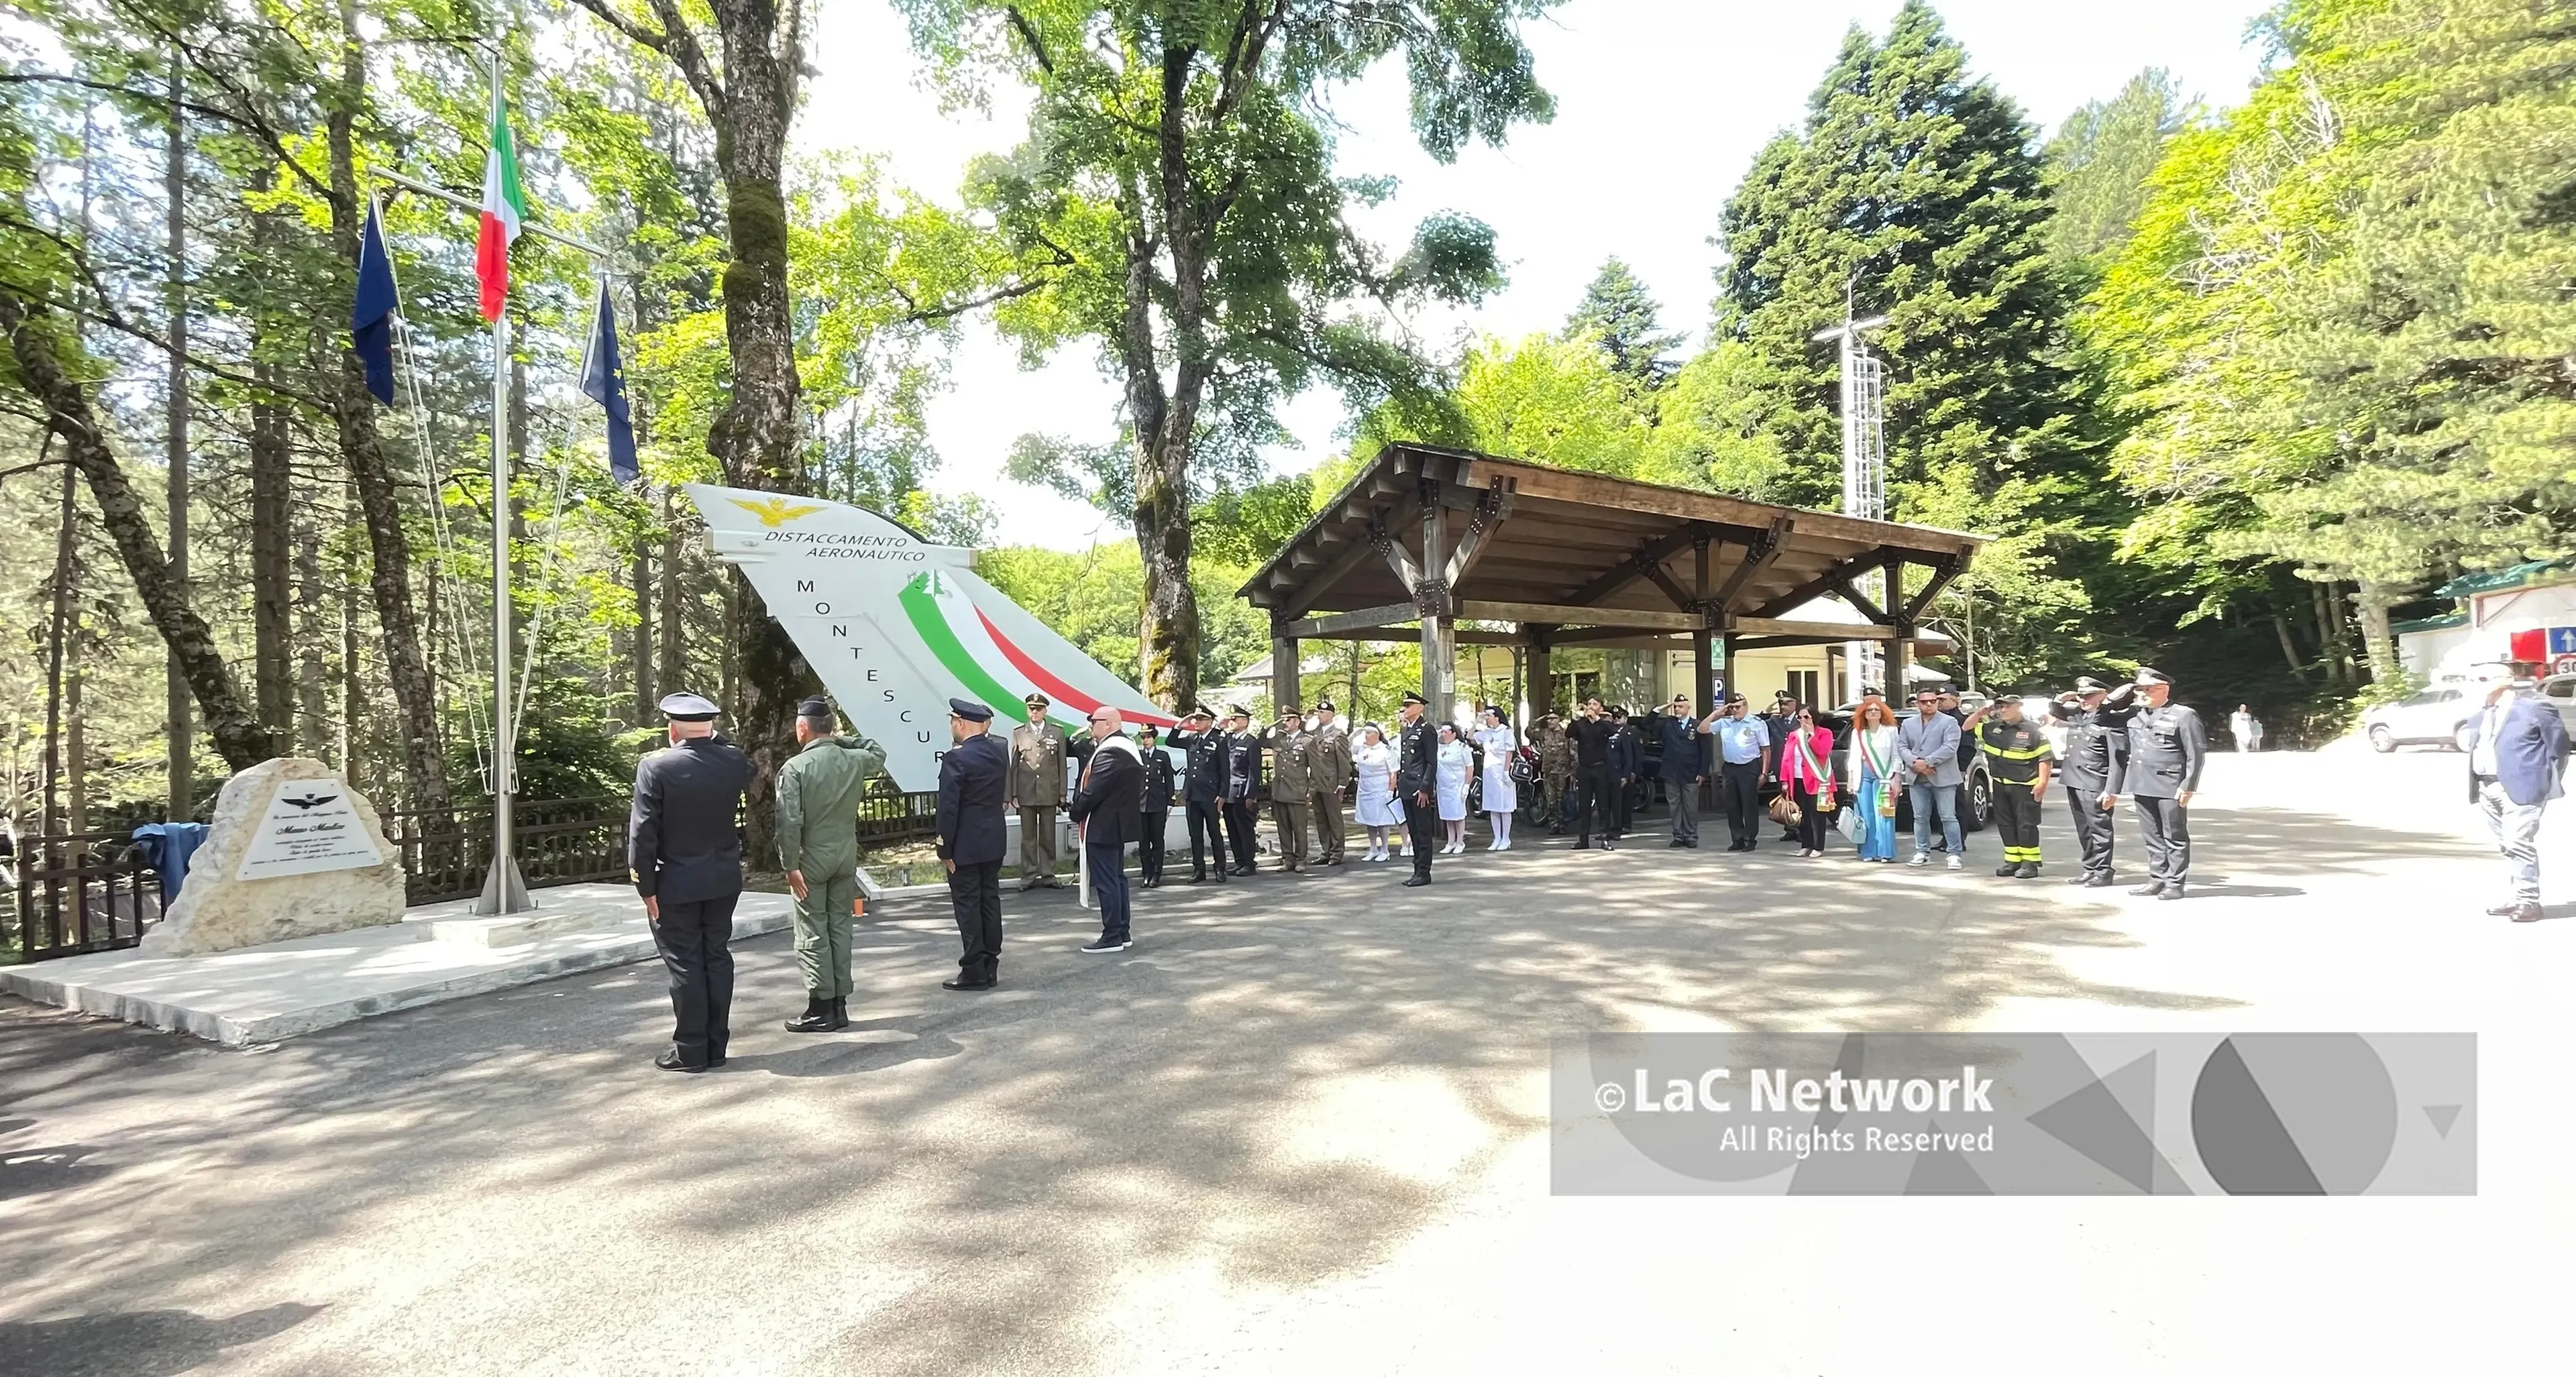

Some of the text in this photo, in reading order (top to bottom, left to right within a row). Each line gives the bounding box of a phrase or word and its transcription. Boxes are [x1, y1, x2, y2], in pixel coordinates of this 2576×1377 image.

[765, 531, 908, 547] DISTACCAMENTO
[805, 547, 926, 561] AERONAUTICO
[797, 580, 945, 763] MONTESCUR
[1714, 679, 1723, 697] P
